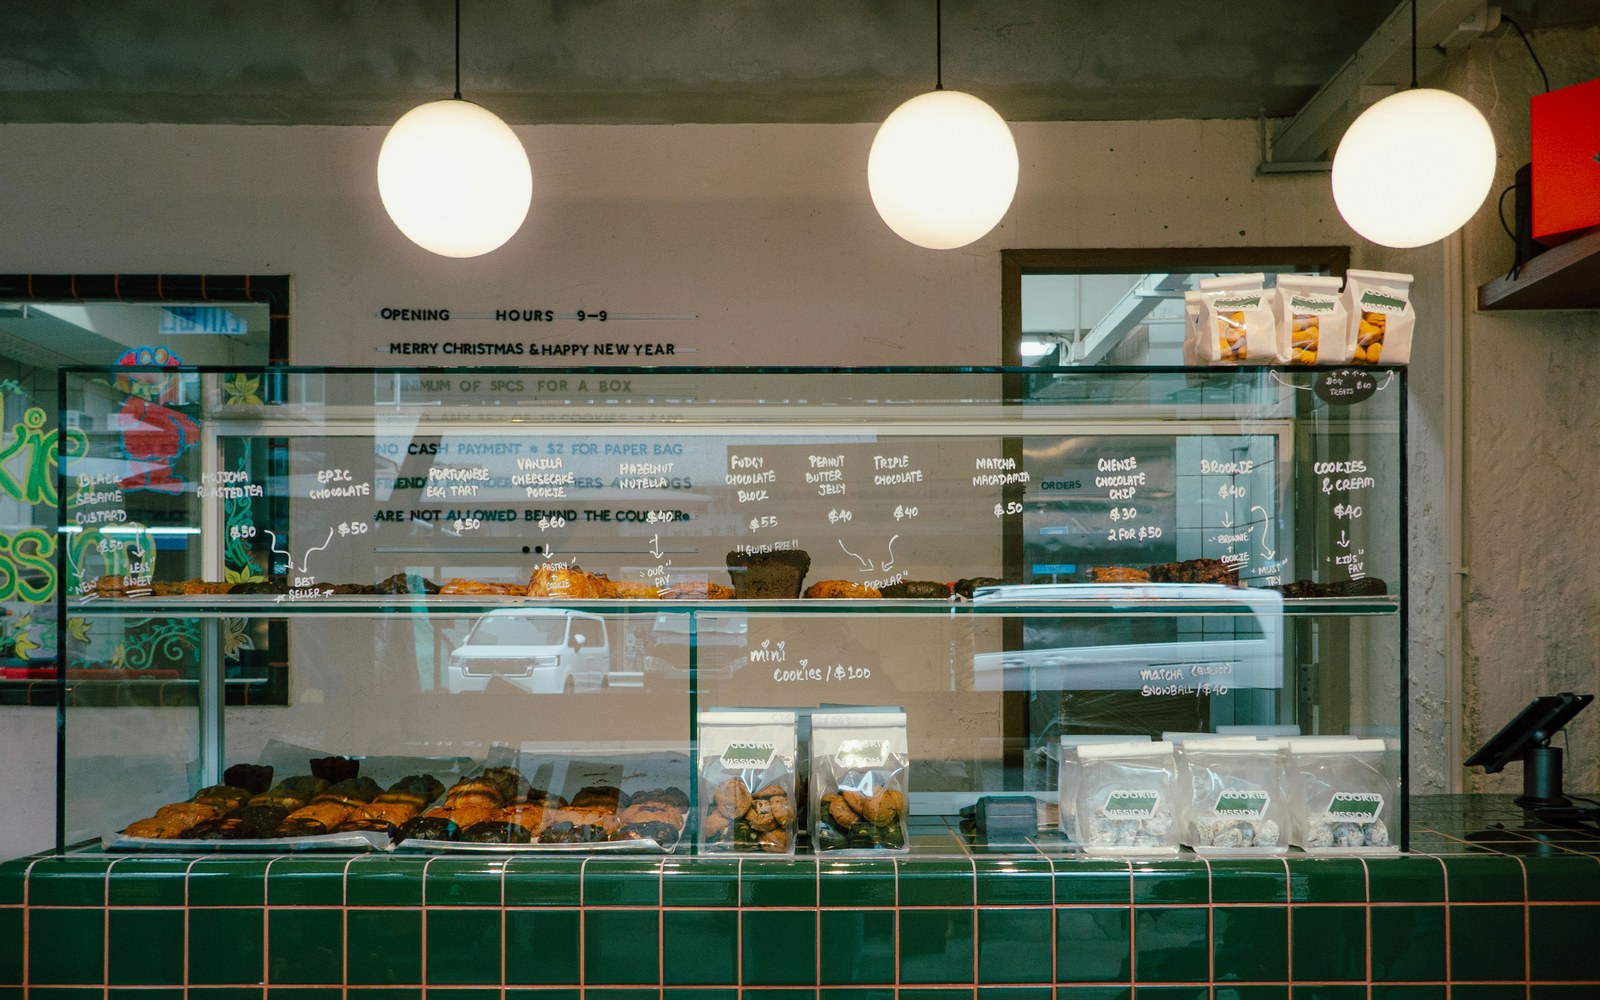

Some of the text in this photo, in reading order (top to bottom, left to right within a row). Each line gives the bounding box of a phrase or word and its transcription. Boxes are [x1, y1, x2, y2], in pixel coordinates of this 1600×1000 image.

[380, 308, 450, 322] OPENING
[496, 310, 554, 322] HOURS
[390, 343, 438, 356] MERRY
[442, 342, 524, 356] CHRISTMAS
[542, 344, 589, 356] HAPPY
[594, 344, 629, 356] NEW
[634, 344, 675, 356] YEAR
[459, 380, 481, 392] OF
[490, 380, 524, 392] 5PCS
[537, 380, 568, 392] FOR
[578, 380, 588, 392] A
[600, 380, 632, 392] BOX
[375, 443, 683, 455] NO CASH PAYMENT $2 FOR PAPER BAG
[517, 457, 563, 470] VANILLA
[620, 463, 674, 475] HAZELNUT
[731, 455, 764, 470] FUDGY
[808, 455, 845, 468] PEANUT
[874, 455, 909, 470] TRIPLE
[976, 457, 1016, 470] MATCHA
[1201, 459, 1254, 474] BROOKIE
[1314, 460, 1366, 475] COOKIES
[318, 469, 352, 484] EPIC
[429, 467, 490, 482] PORTUGUESE
[512, 471, 576, 486] CHEESECAKE
[726, 470, 776, 486] CHOCOLATE
[805, 469, 842, 484] BUTTER
[874, 470, 923, 486] CHOCOLATE
[972, 472, 1030, 486] MACADAMIA
[1095, 472, 1146, 488] CHOCOLATE
[244, 484, 264, 497] TEA
[620, 476, 668, 490] NUTELLA
[818, 484, 846, 496] JELLY
[1041, 480, 1082, 490] ORDERS
[1322, 477, 1374, 495] & CREAM
[309, 482, 370, 500] CHOCOLATE
[426, 486, 479, 498] EGG TART
[737, 490, 770, 503] BLOCK
[1109, 486, 1136, 500] CHIP
[1218, 484, 1246, 499] $40
[76, 511, 127, 524] CUSTARD
[376, 509, 682, 522] ARE NOT ALLOWED BEHIND THE COUR
[646, 510, 673, 524] $40
[828, 508, 852, 524] $40
[894, 504, 918, 521] $40
[994, 502, 1023, 518] $50
[1110, 507, 1137, 522] $30
[1334, 503, 1362, 520] $40
[338, 522, 368, 538] $50
[454, 518, 481, 534] $50
[538, 516, 566, 532] $60
[749, 516, 778, 532] $55
[230, 525, 256, 540] $50
[1108, 526, 1162, 541] 2 FOR $50
[1220, 552, 1250, 564] COOKIE
[1348, 562, 1364, 574] FAV
[294, 576, 316, 588] BEST
[654, 574, 670, 587] FAV
[1265, 575, 1282, 586] TRY
[288, 588, 320, 600] SELLER
[750, 640, 786, 662] mini
[834, 664, 871, 681] $100
[1222, 792, 1266, 800] COOKIE
